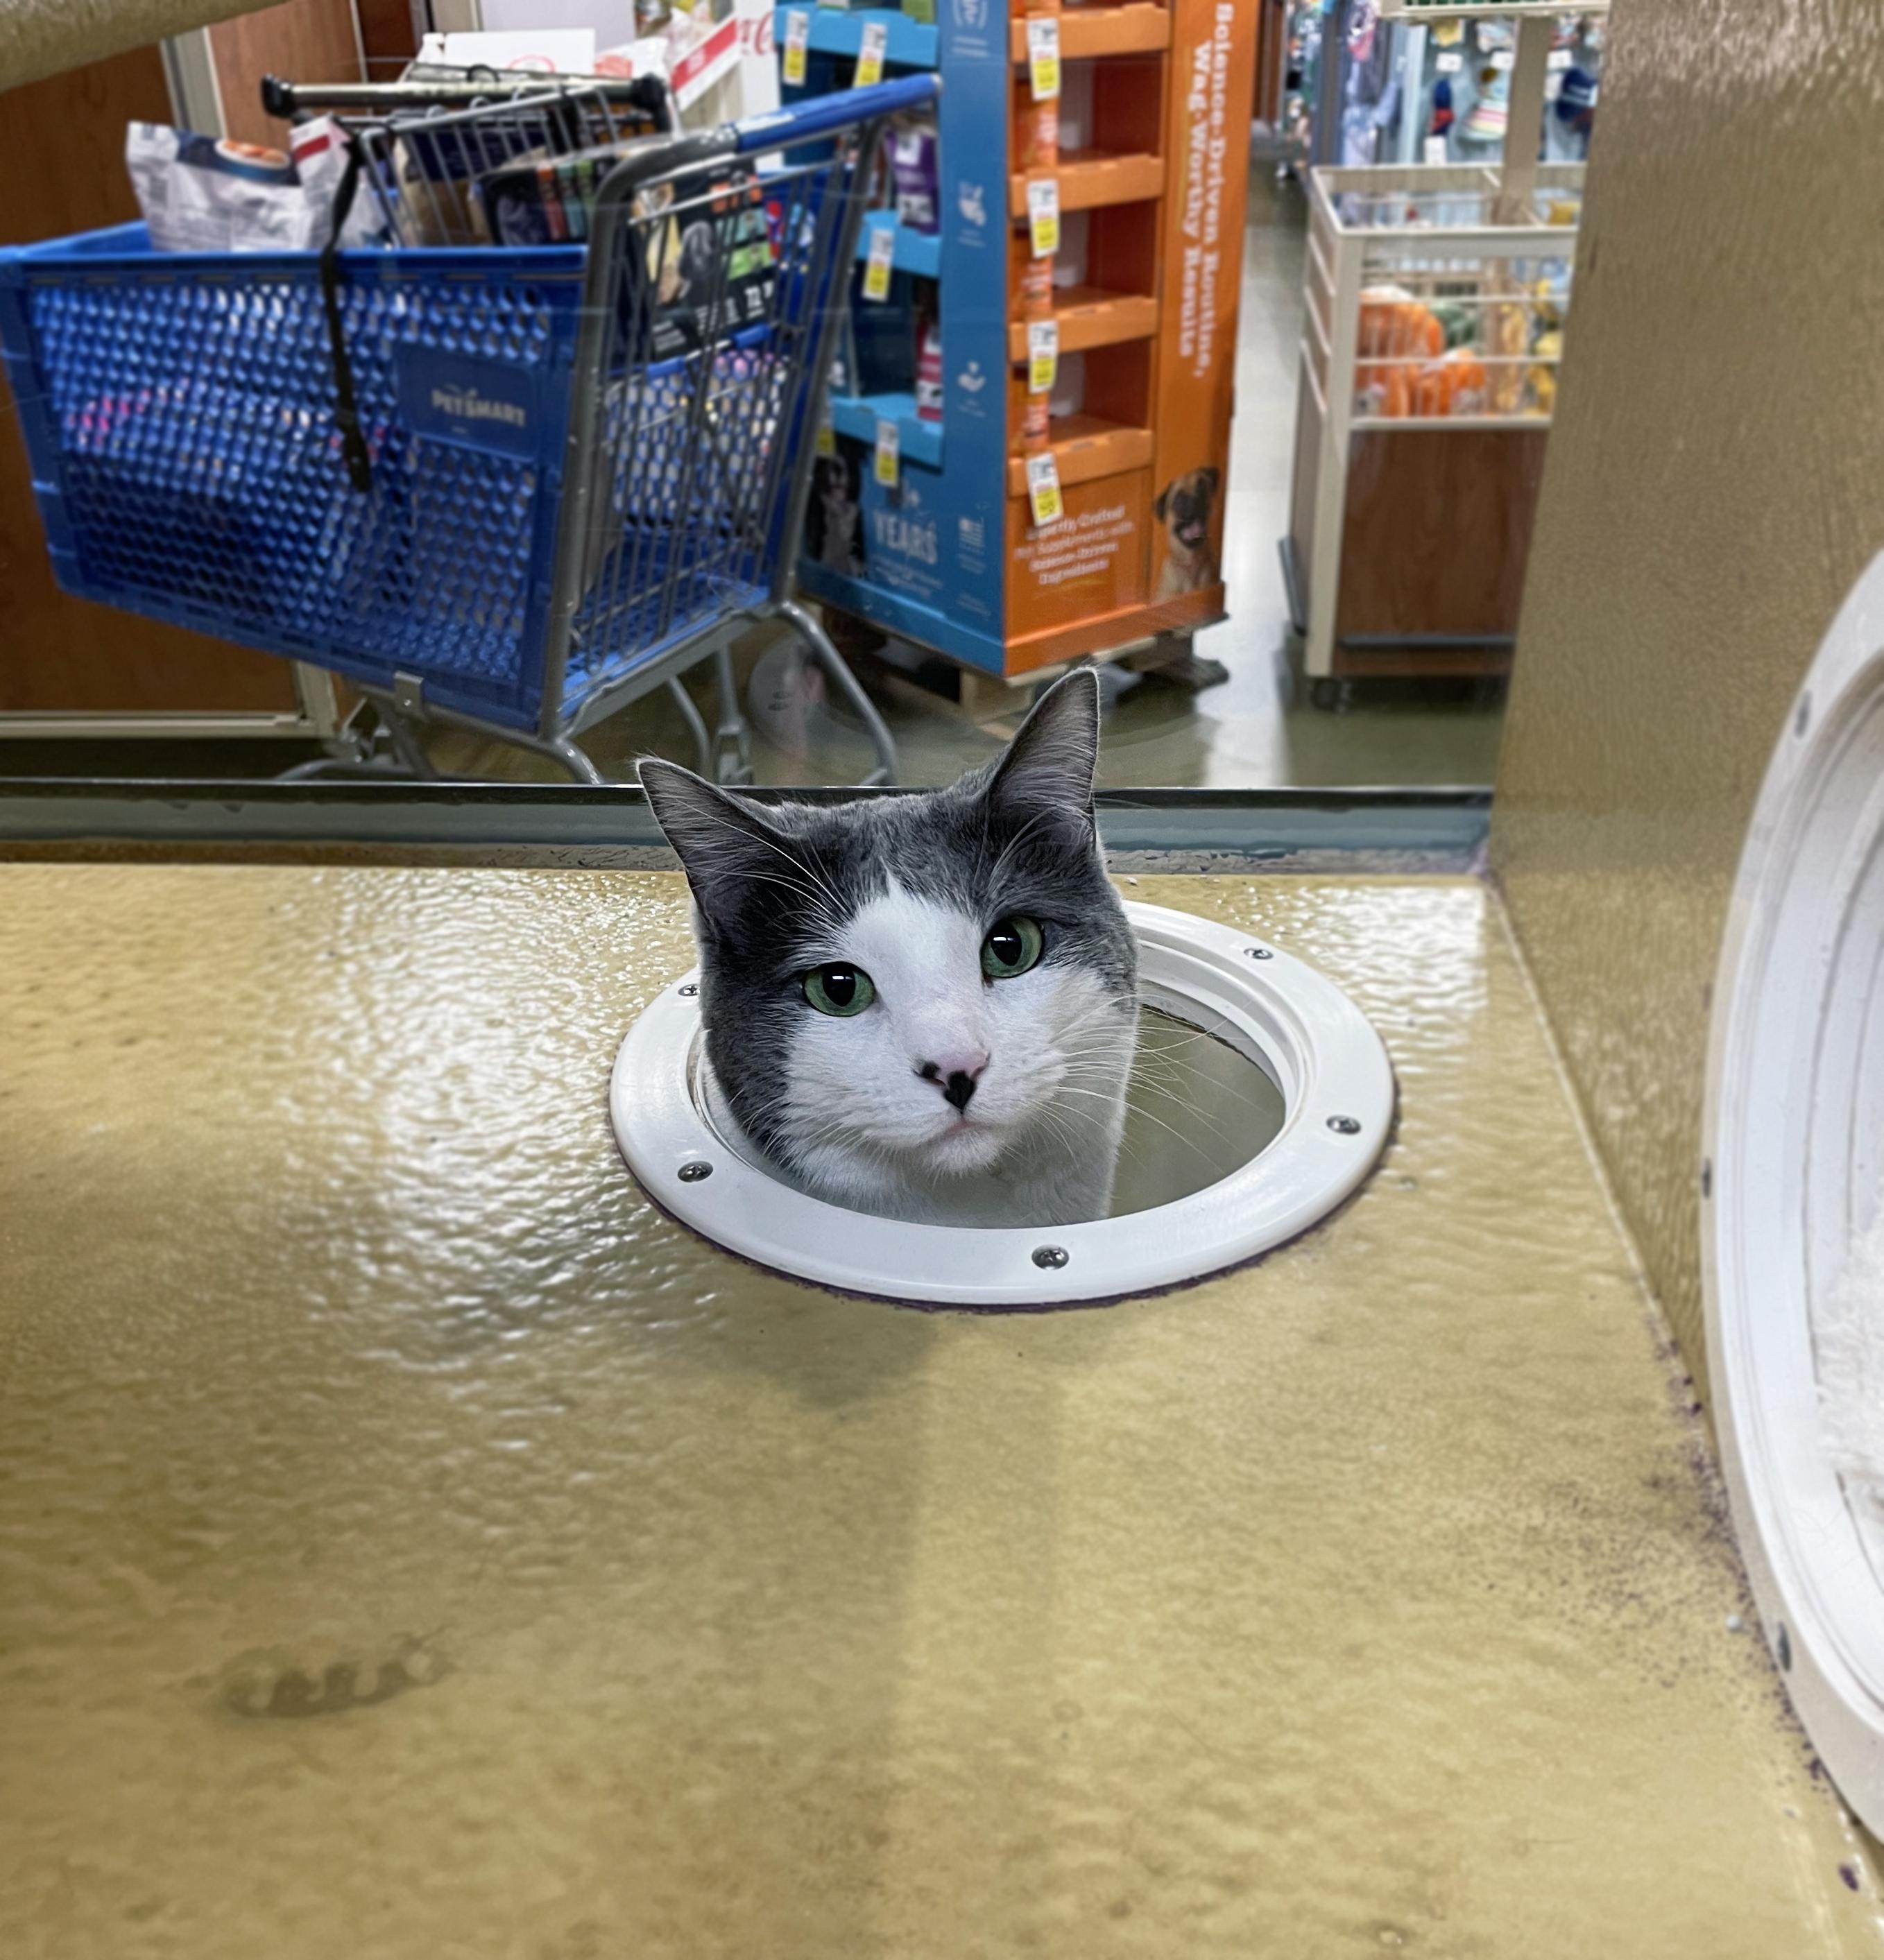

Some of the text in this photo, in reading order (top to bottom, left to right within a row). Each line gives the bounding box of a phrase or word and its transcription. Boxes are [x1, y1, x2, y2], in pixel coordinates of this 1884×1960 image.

[1179, 40, 1212, 356] Wag-Worthy Results
[1207, 3, 1234, 243] Science-Driven
